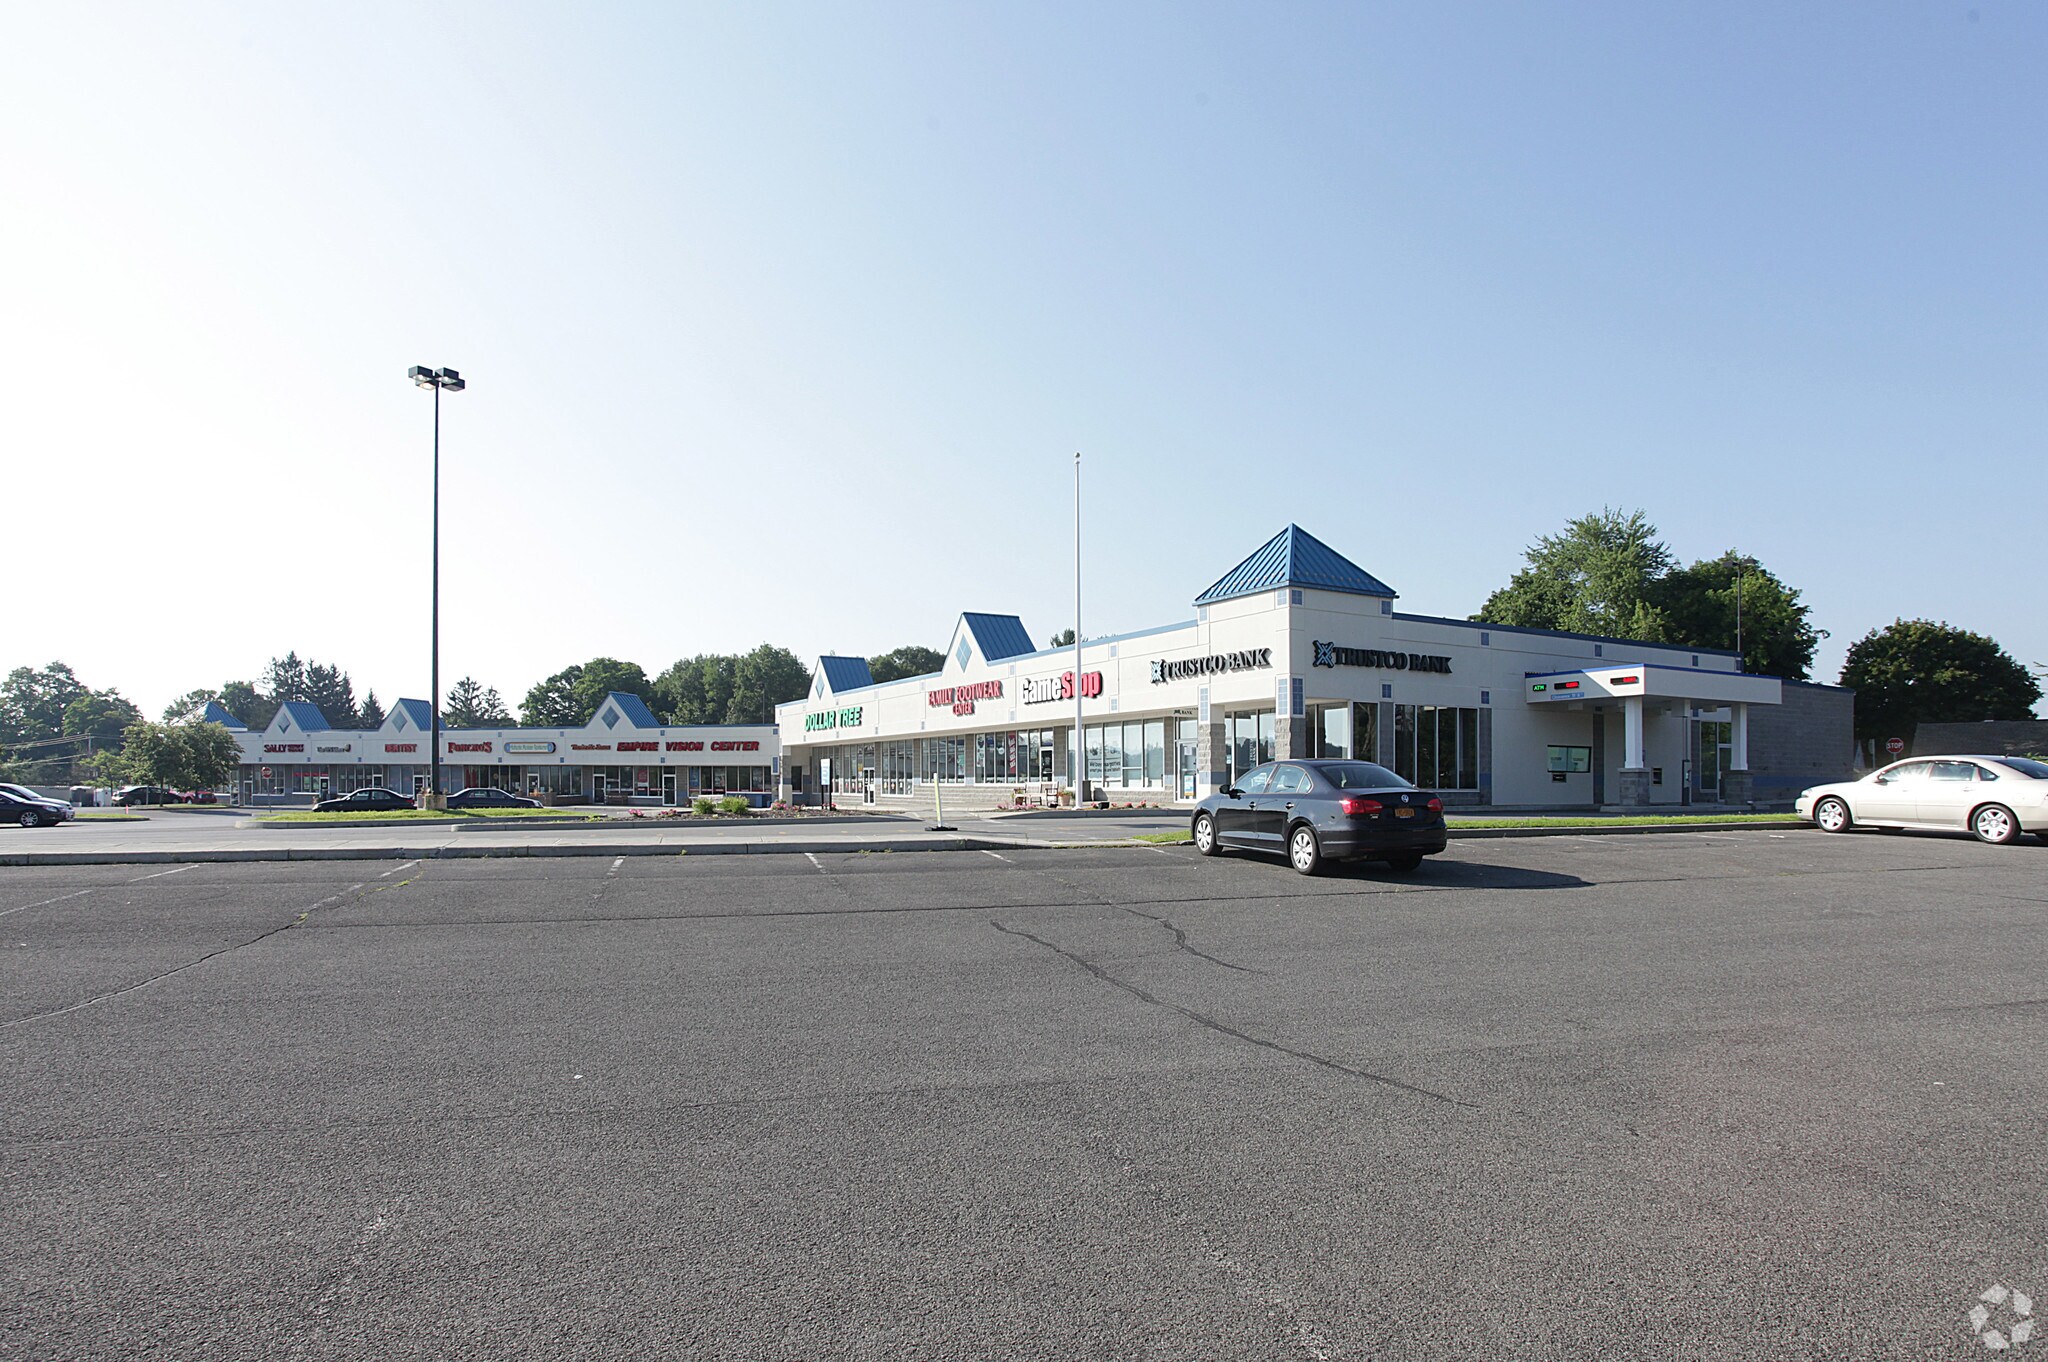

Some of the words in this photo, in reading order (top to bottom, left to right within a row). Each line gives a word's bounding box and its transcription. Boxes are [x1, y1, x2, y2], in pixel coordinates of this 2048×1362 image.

[1163, 654, 1227, 681] TRUSTCO
[1226, 648, 1272, 672] BANK
[1333, 647, 1408, 670] TRUSTCO
[1408, 654, 1452, 673] BANK
[928, 687, 955, 707] FAMILY
[956, 680, 1004, 702] FOOTWEAR
[805, 710, 836, 732] DOLLAR
[838, 706, 863, 728] TREE
[953, 702, 975, 717] CENTER
[264, 744, 287, 753] SALLY
[617, 742, 659, 751] EMPIRE
[666, 742, 704, 751] VISION
[711, 741, 760, 751] CENTER
